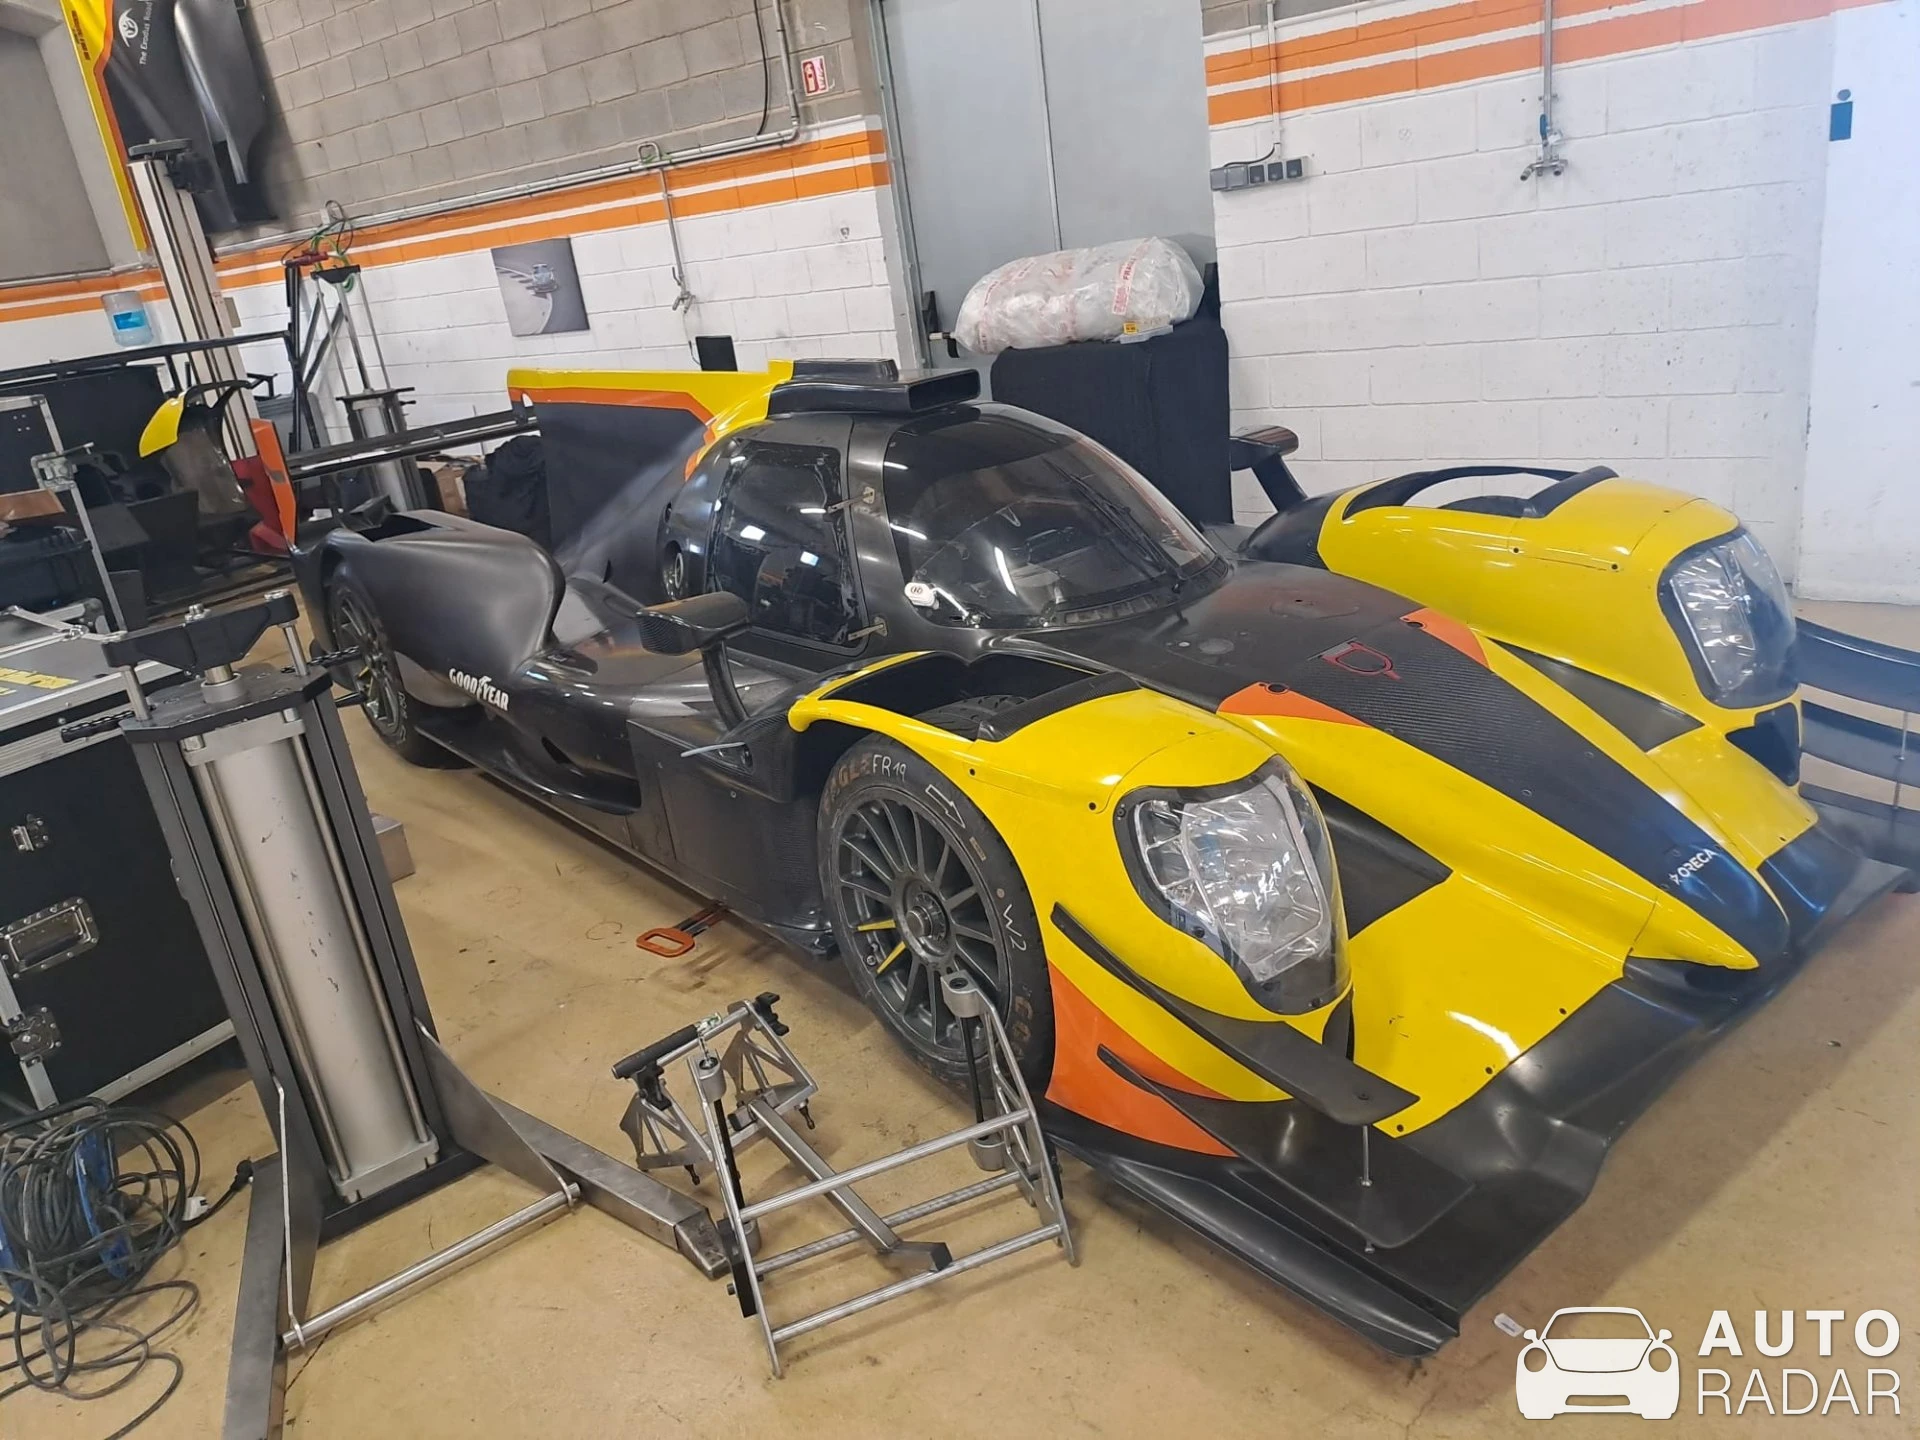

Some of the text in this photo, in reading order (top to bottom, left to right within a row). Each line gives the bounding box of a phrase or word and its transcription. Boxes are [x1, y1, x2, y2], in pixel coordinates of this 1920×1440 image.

[139, 1, 153, 65] The Exodus Road
[449, 668, 509, 711] GOODYEAR
[1677, 848, 1717, 878] ORECA
